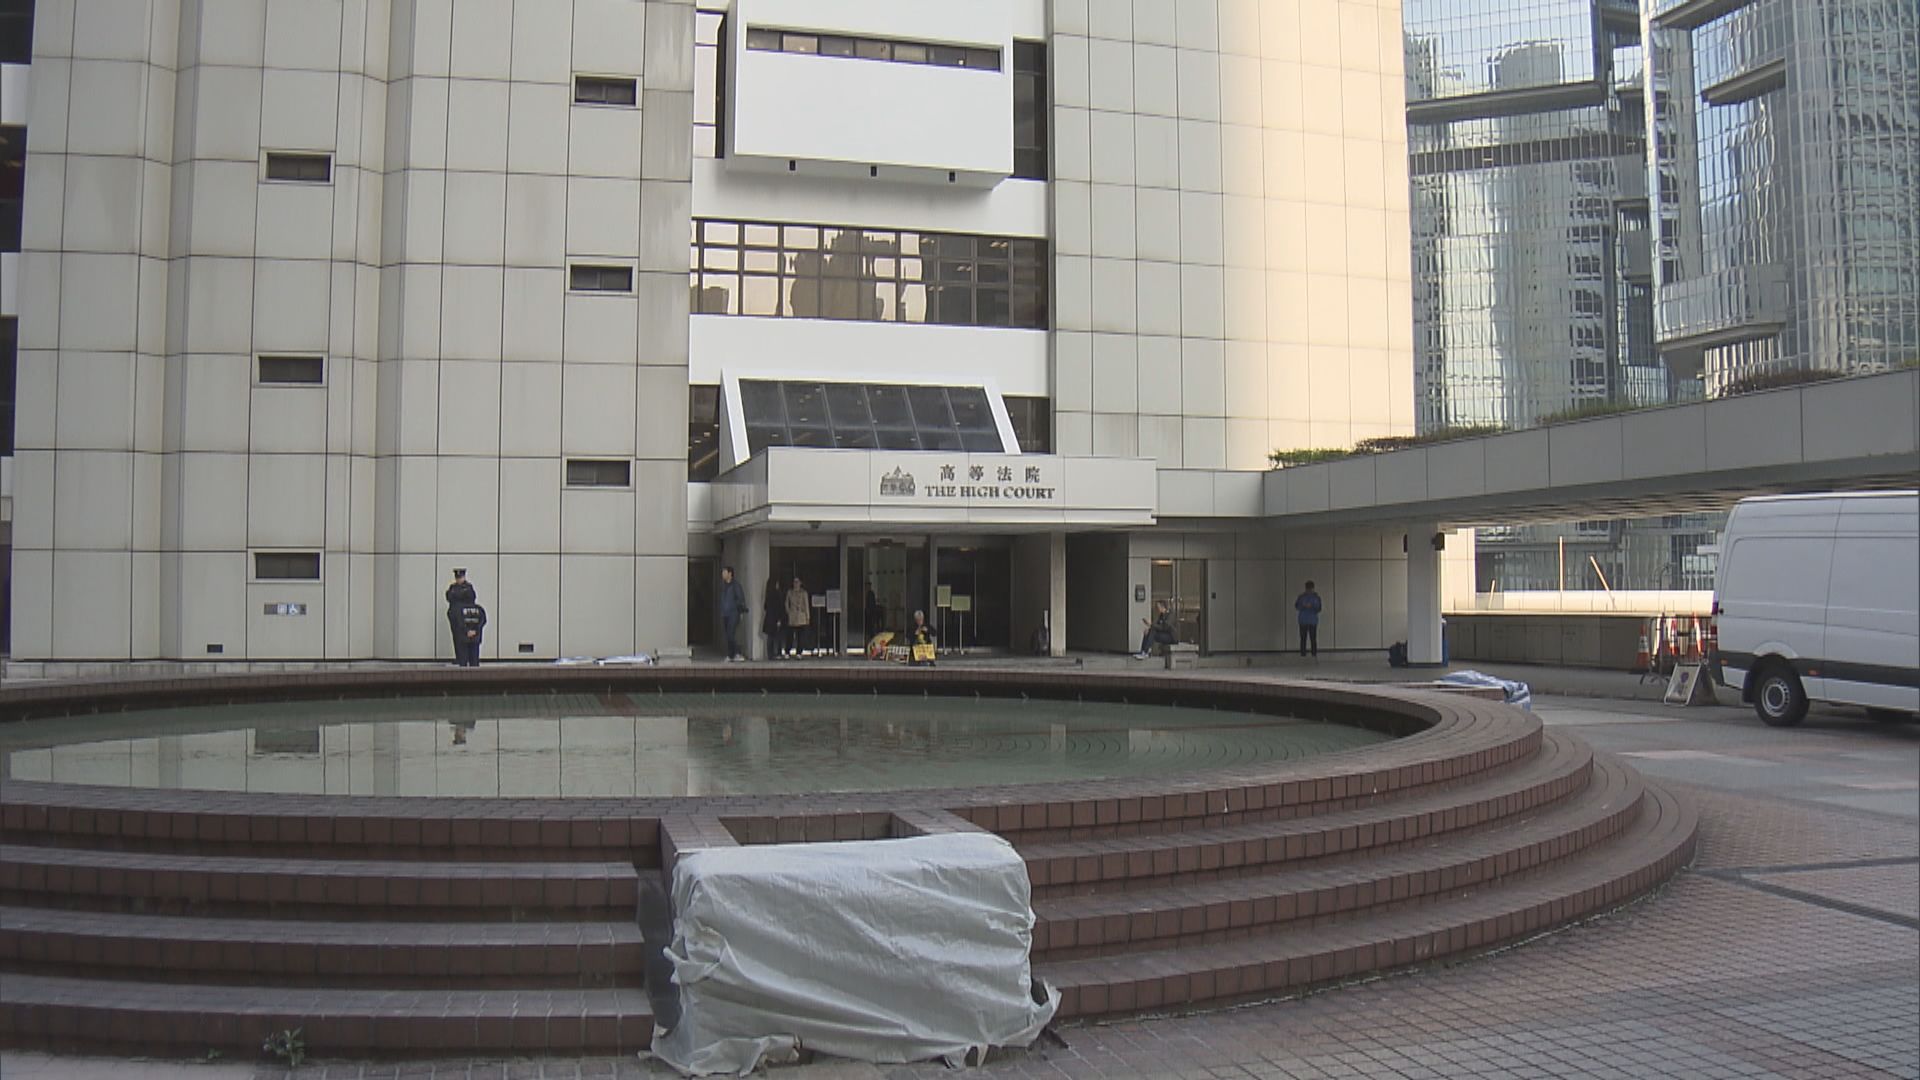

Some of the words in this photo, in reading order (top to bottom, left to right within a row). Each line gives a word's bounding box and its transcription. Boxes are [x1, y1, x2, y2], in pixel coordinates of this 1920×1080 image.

[940, 464, 1041, 483] 高等法院
[924, 485, 957, 498] THE
[960, 485, 1000, 498] HIGH
[1003, 486, 1056, 499] COURT
